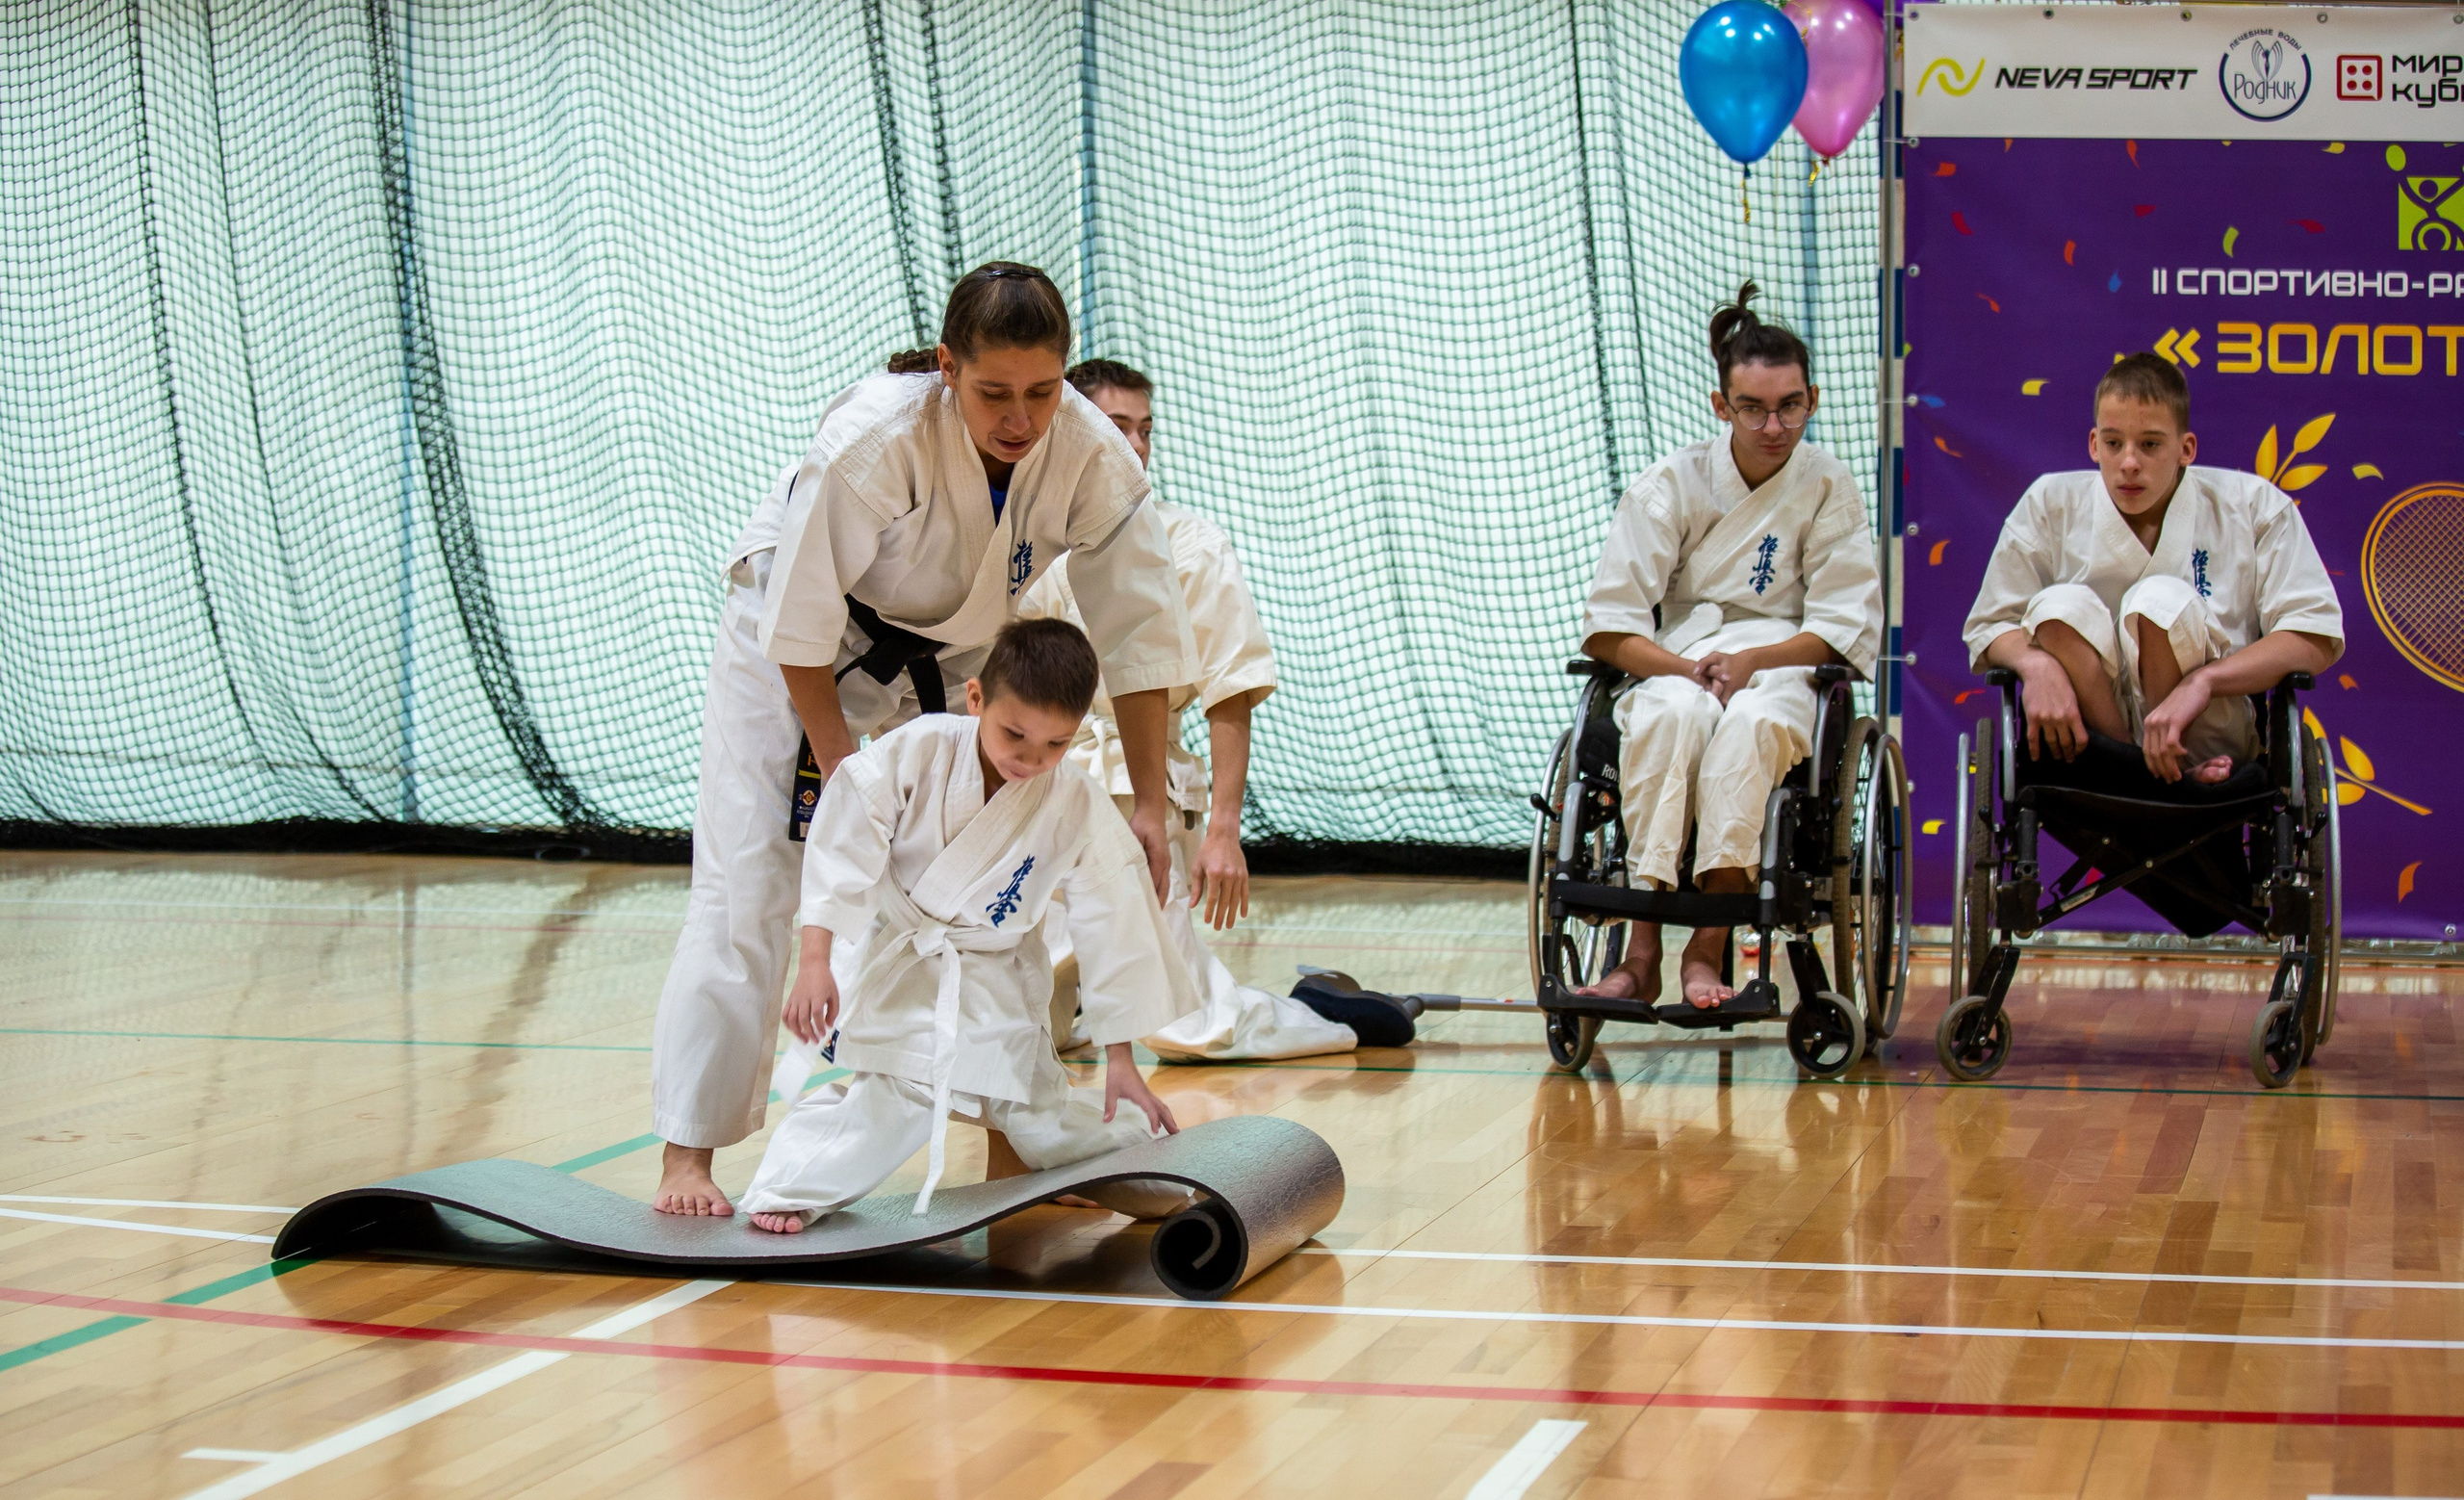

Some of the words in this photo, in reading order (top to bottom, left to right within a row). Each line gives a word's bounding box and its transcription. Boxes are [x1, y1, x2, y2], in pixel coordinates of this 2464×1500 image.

[2229, 29, 2273, 50] ЛЕЧЕБНЫЕ
[2278, 32, 2302, 51] ВОДЫ
[1995, 67, 2082, 90] NEVA
[2086, 68, 2198, 91] SPORT
[2234, 73, 2297, 105] Родник
[2392, 78, 2464, 108] куб
